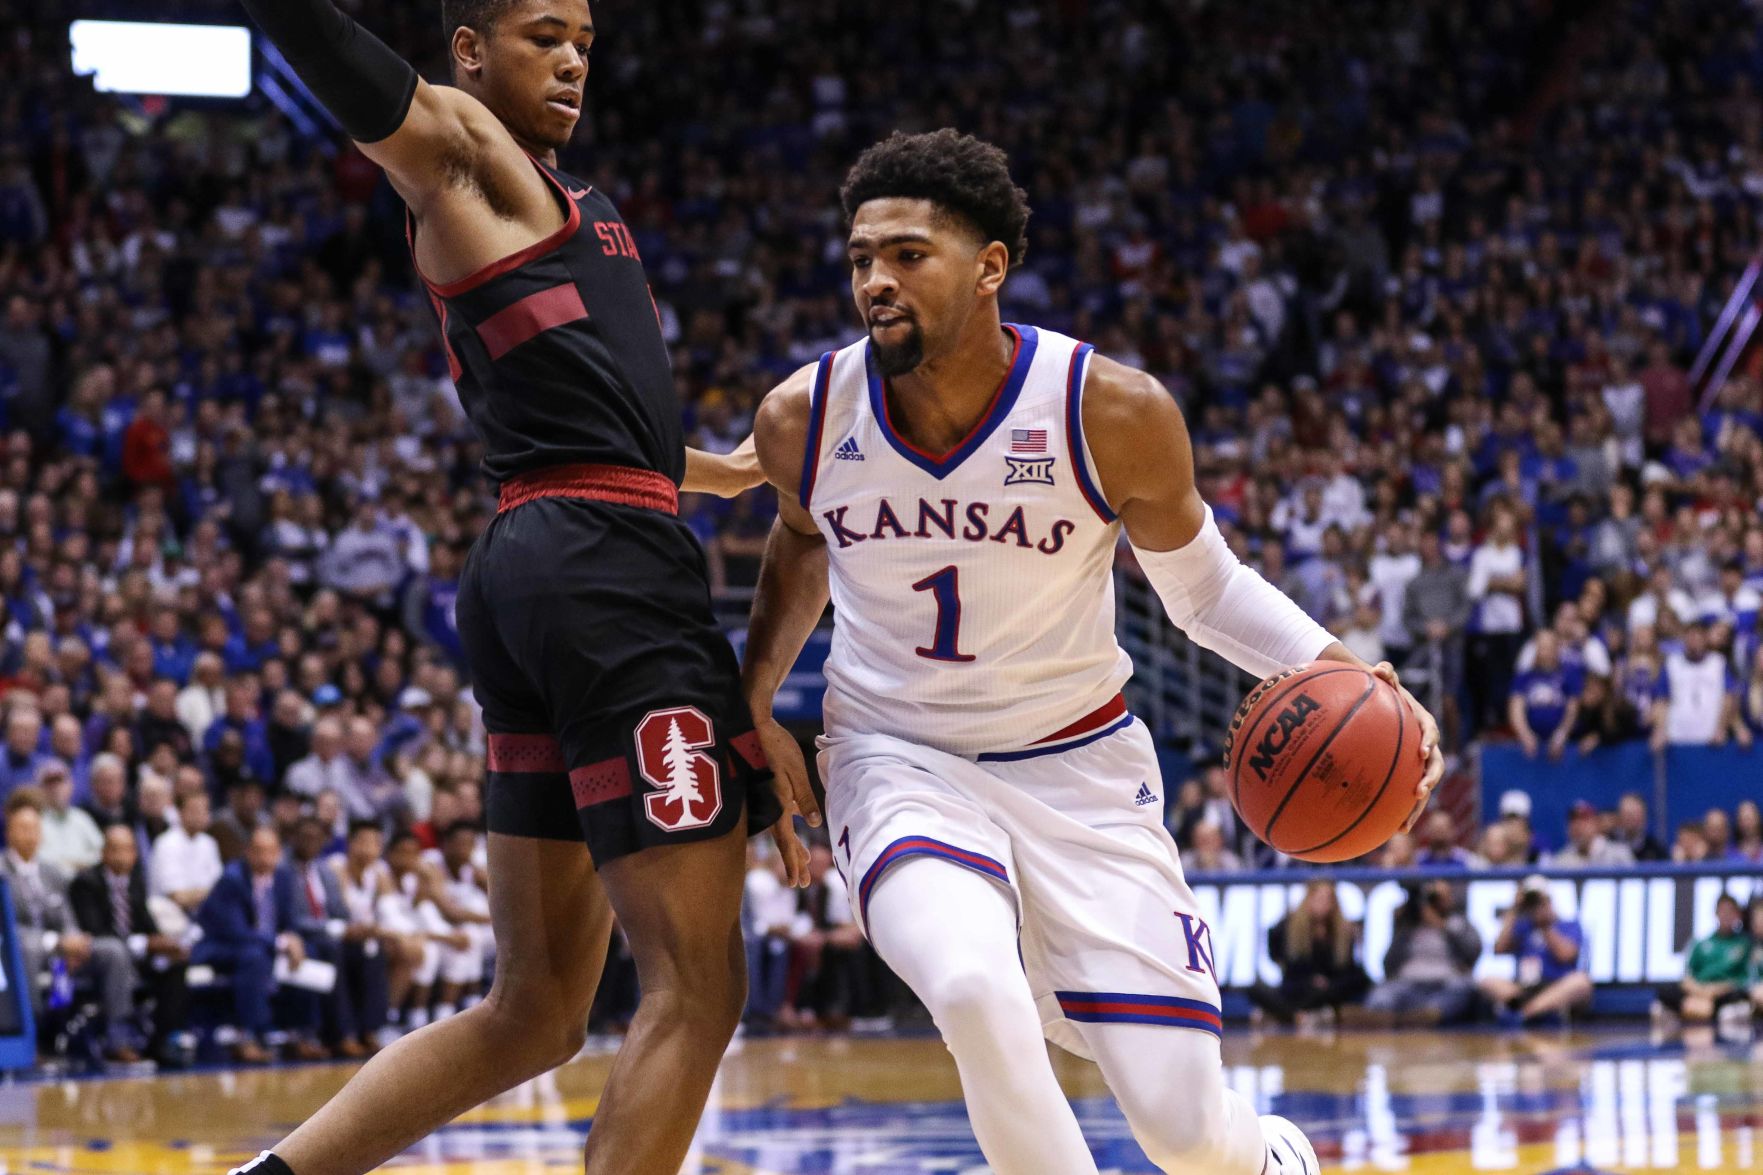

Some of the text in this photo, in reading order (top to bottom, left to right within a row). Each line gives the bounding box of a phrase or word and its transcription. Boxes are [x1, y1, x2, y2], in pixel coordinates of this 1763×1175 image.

[1008, 459, 1051, 481] XII
[823, 497, 1076, 555] KANSAS
[911, 564, 977, 662] 1
[1248, 693, 1322, 782] NCAA
[1174, 911, 1219, 986] K
[1192, 879, 1518, 987] MUCE
